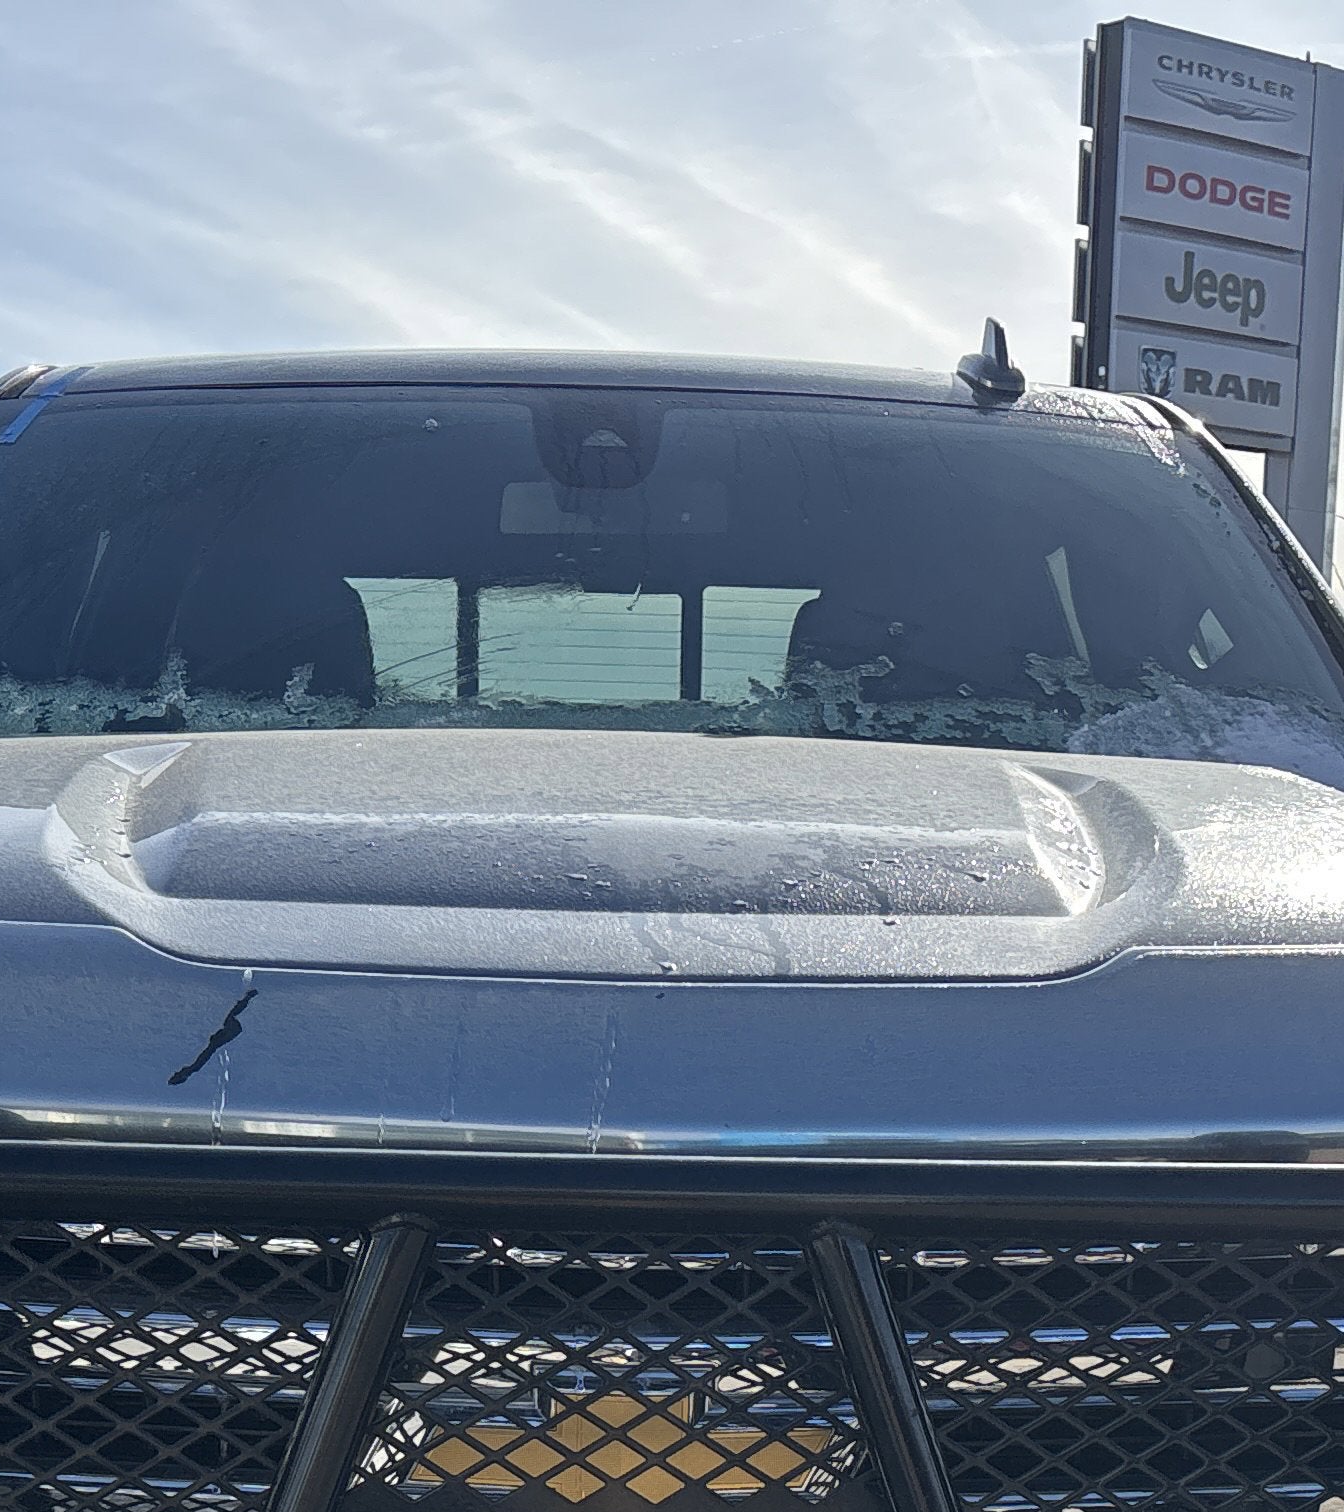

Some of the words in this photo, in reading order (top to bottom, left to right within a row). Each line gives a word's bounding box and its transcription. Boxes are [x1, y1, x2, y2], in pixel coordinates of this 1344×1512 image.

[1157, 54, 1295, 101] CHRYSLER
[1145, 164, 1292, 220] DODGE
[1164, 251, 1267, 327] Jeep
[1183, 366, 1281, 408] RAM
